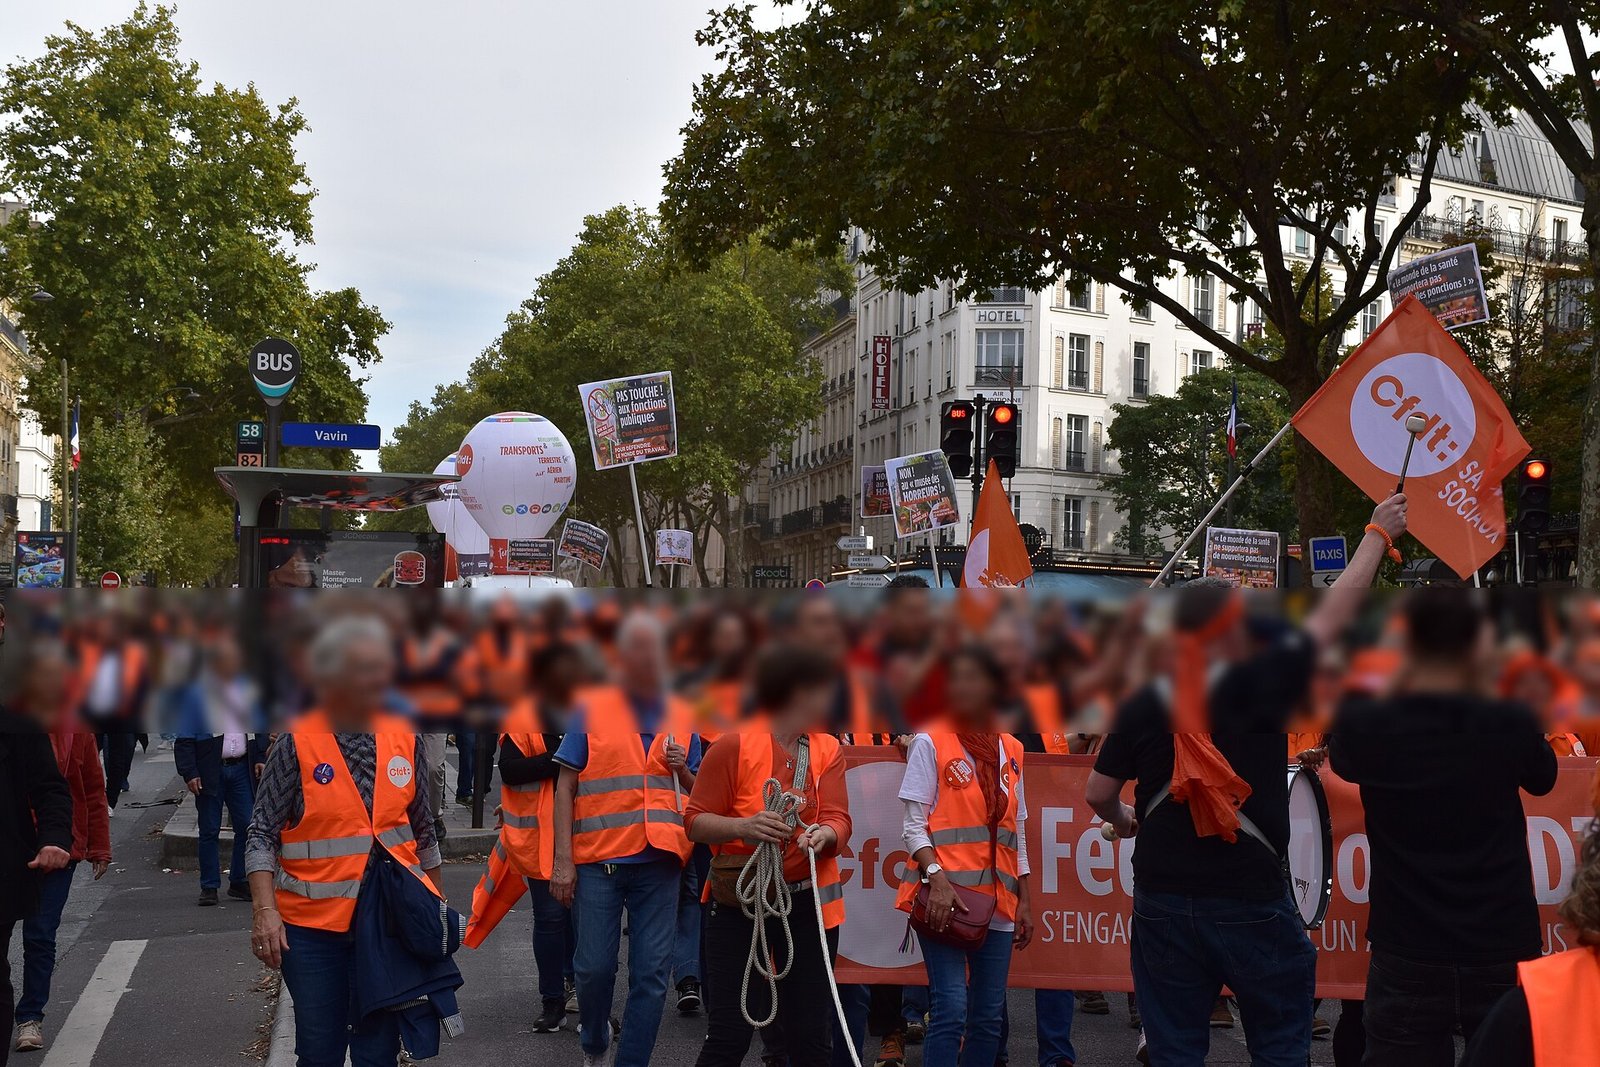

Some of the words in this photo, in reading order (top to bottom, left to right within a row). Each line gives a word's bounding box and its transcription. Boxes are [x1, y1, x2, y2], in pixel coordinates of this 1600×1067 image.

[1401, 270, 1420, 283] monde
[1420, 266, 1429, 276] de
[1430, 263, 1437, 272] la
[1438, 256, 1458, 270] santé
[1429, 273, 1442, 286] pas
[1427, 278, 1462, 298] ponctions
[978, 310, 1021, 322] HOTEL
[257, 352, 293, 371] BUS
[876, 342, 887, 399] HOTEL
[616, 388, 628, 402] PAS
[630, 385, 659, 400] TOUCHE
[618, 403, 630, 414] aux
[631, 398, 667, 413] fonctions
[620, 412, 655, 428] publiques
[242, 424, 259, 437] 58
[315, 430, 348, 441] Vavin
[500, 445, 544, 456] TRANSPORTS
[626, 442, 651, 451] DÉFENDRE
[644, 446, 666, 454] TRAVAIL
[241, 455, 258, 466] 82
[899, 467, 912, 479] NON
[901, 482, 909, 490] au
[914, 475, 931, 485] musée
[931, 474, 940, 483] des
[1228, 536, 1244, 544] monde
[1222, 545, 1249, 554] supportera
[1315, 549, 1343, 560] TAXIS
[1245, 556, 1269, 564] ponctions
[322, 576, 362, 584] Montagnard
[1042, 910, 1132, 944] S'ENGA
